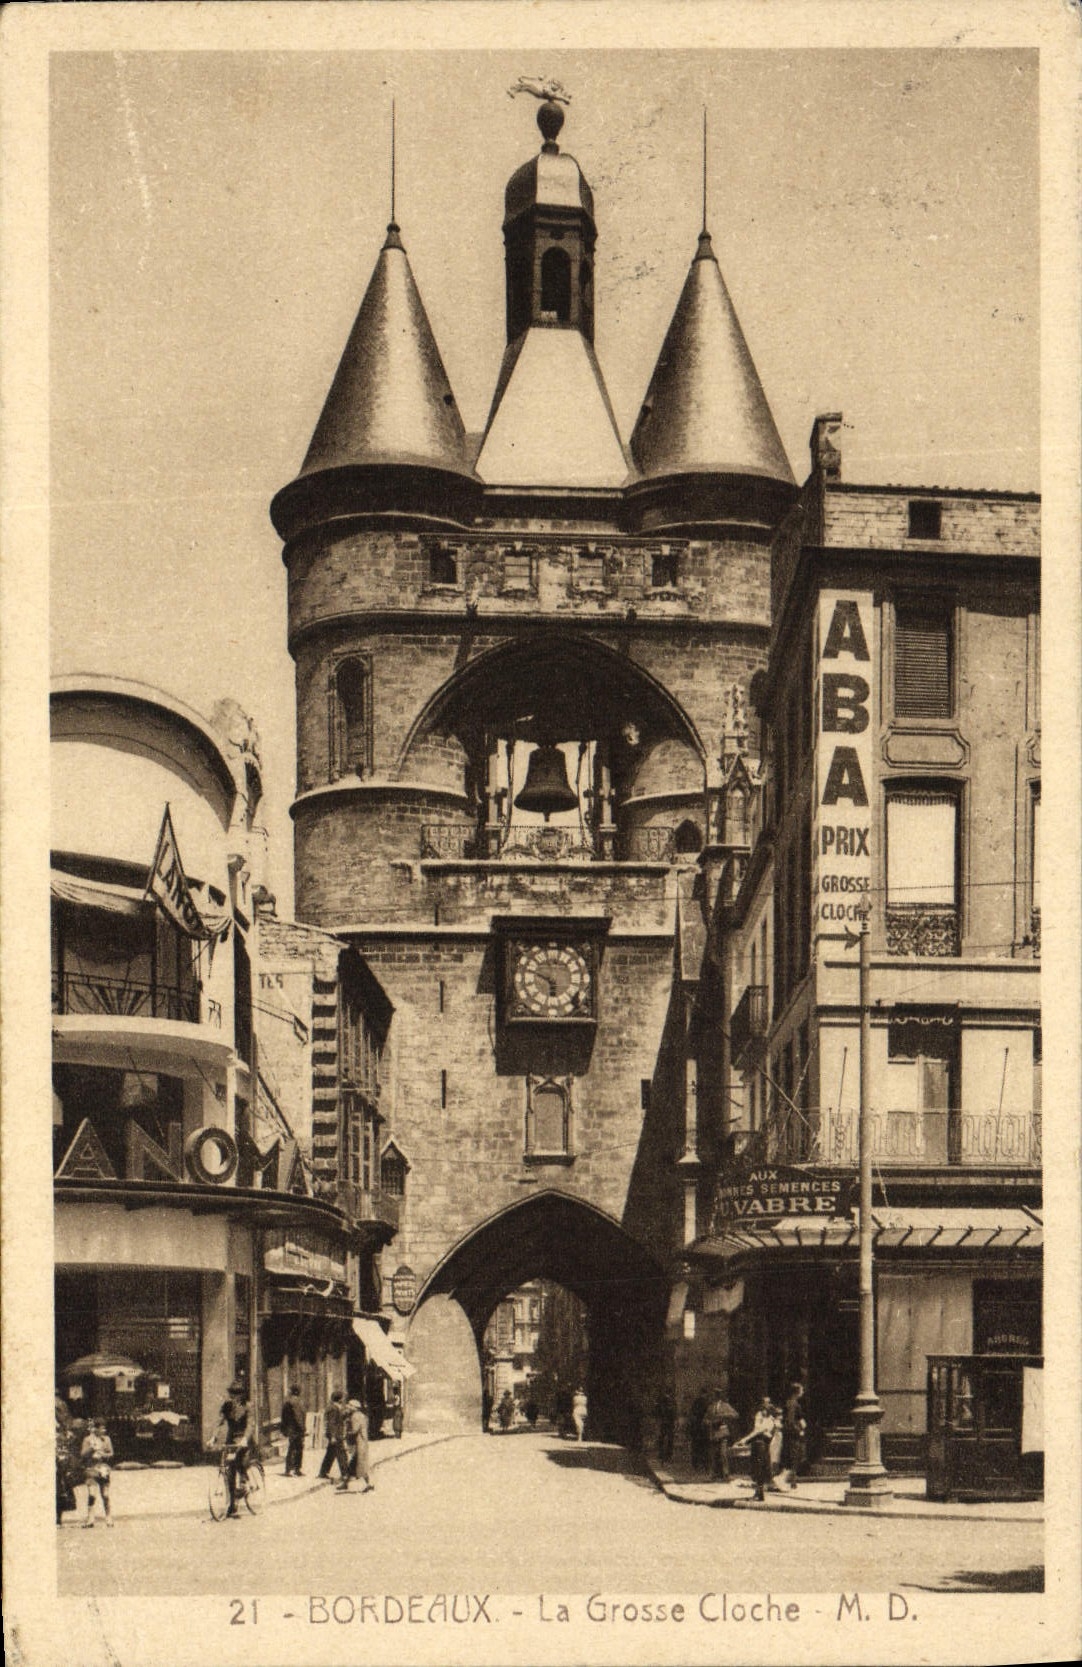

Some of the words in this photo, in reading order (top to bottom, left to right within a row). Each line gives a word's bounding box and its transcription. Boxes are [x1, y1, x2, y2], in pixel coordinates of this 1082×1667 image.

[821, 825, 871, 857] PRIX
[821, 875, 870, 893] GROSSE
[821, 903, 871, 922] CLOCH
[749, 1170, 777, 1182] AUX
[761, 1181, 841, 1194] SEMENCES
[734, 1196, 836, 1215] VABRE
